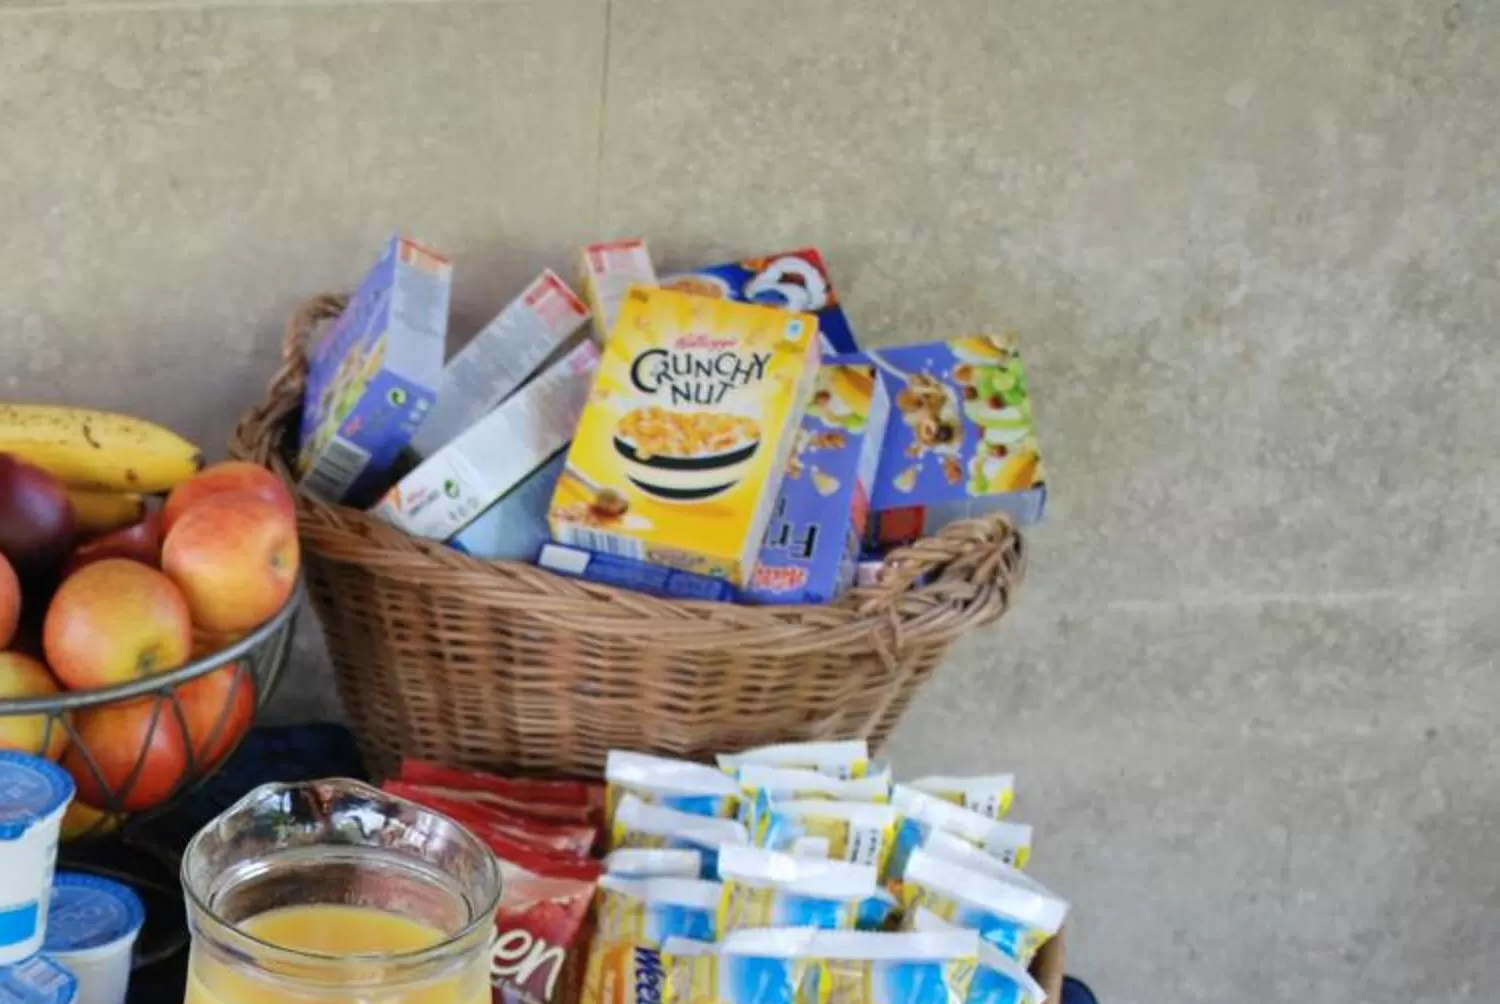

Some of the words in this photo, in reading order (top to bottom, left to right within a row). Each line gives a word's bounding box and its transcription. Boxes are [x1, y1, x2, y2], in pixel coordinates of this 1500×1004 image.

[630, 348, 772, 393] CRUNCHY
[670, 381, 735, 405] NUT
[489, 927, 566, 1001] en
